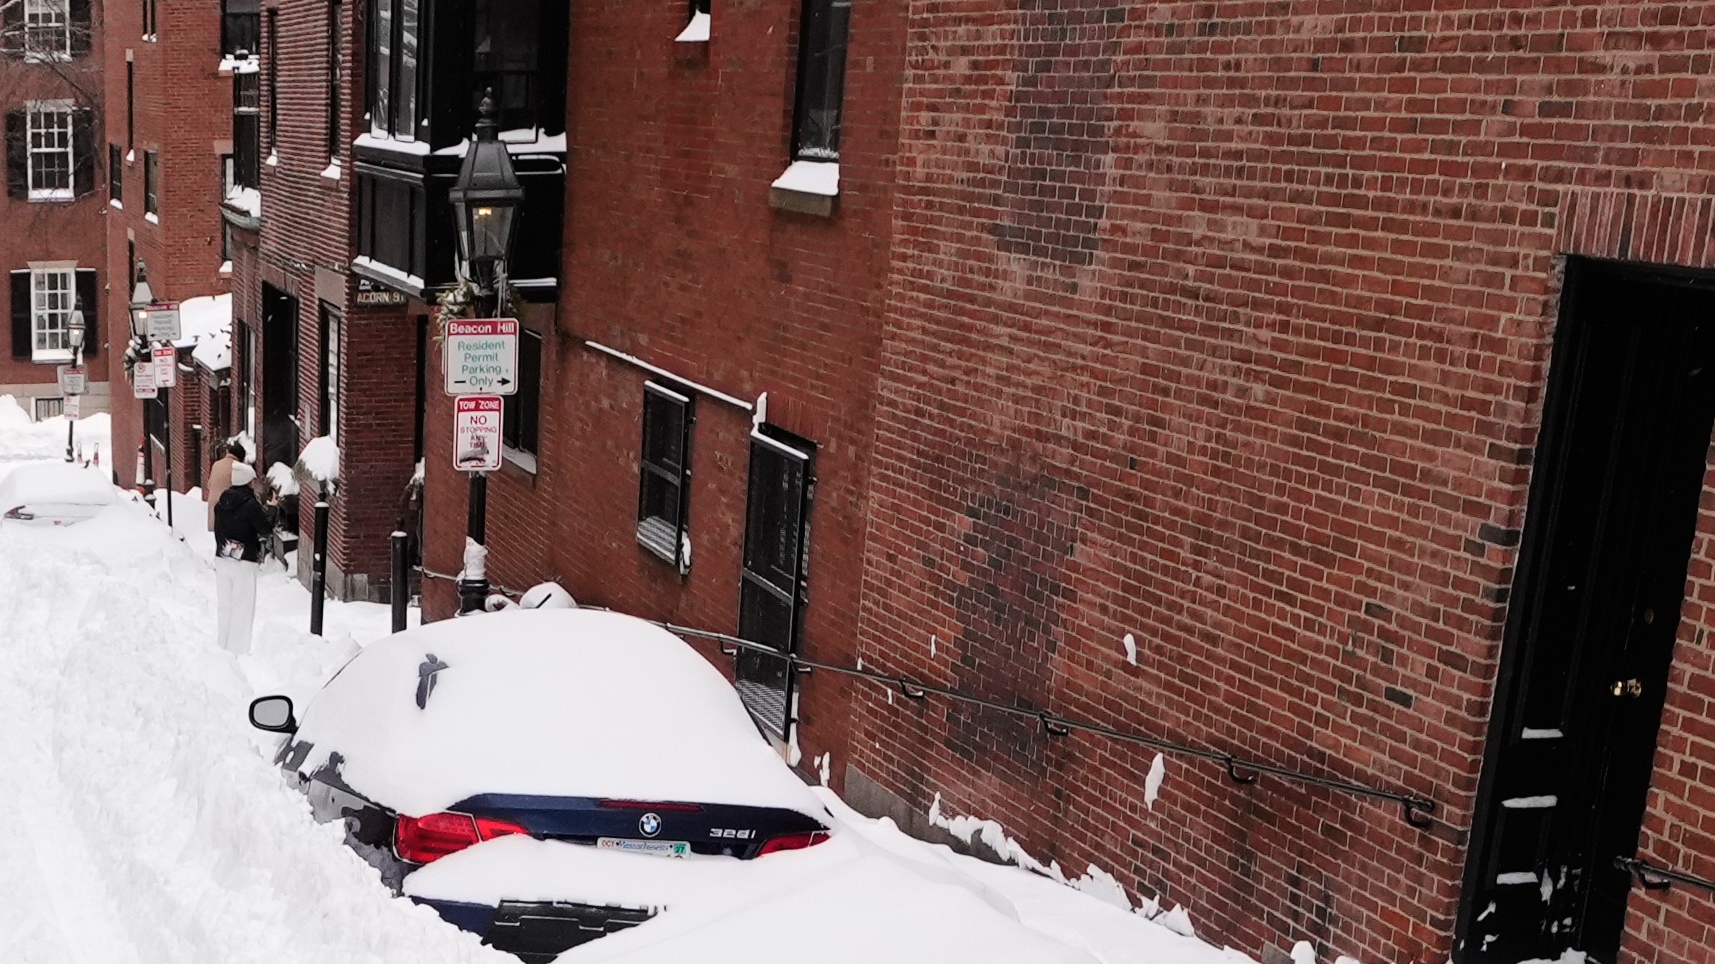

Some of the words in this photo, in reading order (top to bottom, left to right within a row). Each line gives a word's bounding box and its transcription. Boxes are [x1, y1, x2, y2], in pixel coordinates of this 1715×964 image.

[357, 292, 390, 303] ACORN
[449, 322, 492, 334] Beacon
[497, 322, 515, 333] Hill
[457, 340, 506, 351] Resident
[464, 352, 499, 362] Permit
[461, 364, 502, 375] Parking
[469, 376, 494, 387] Only
[459, 401, 476, 410] TOW
[478, 400, 500, 410] ZONE
[470, 415, 488, 425] NO
[460, 426, 497, 434] STOPPING
